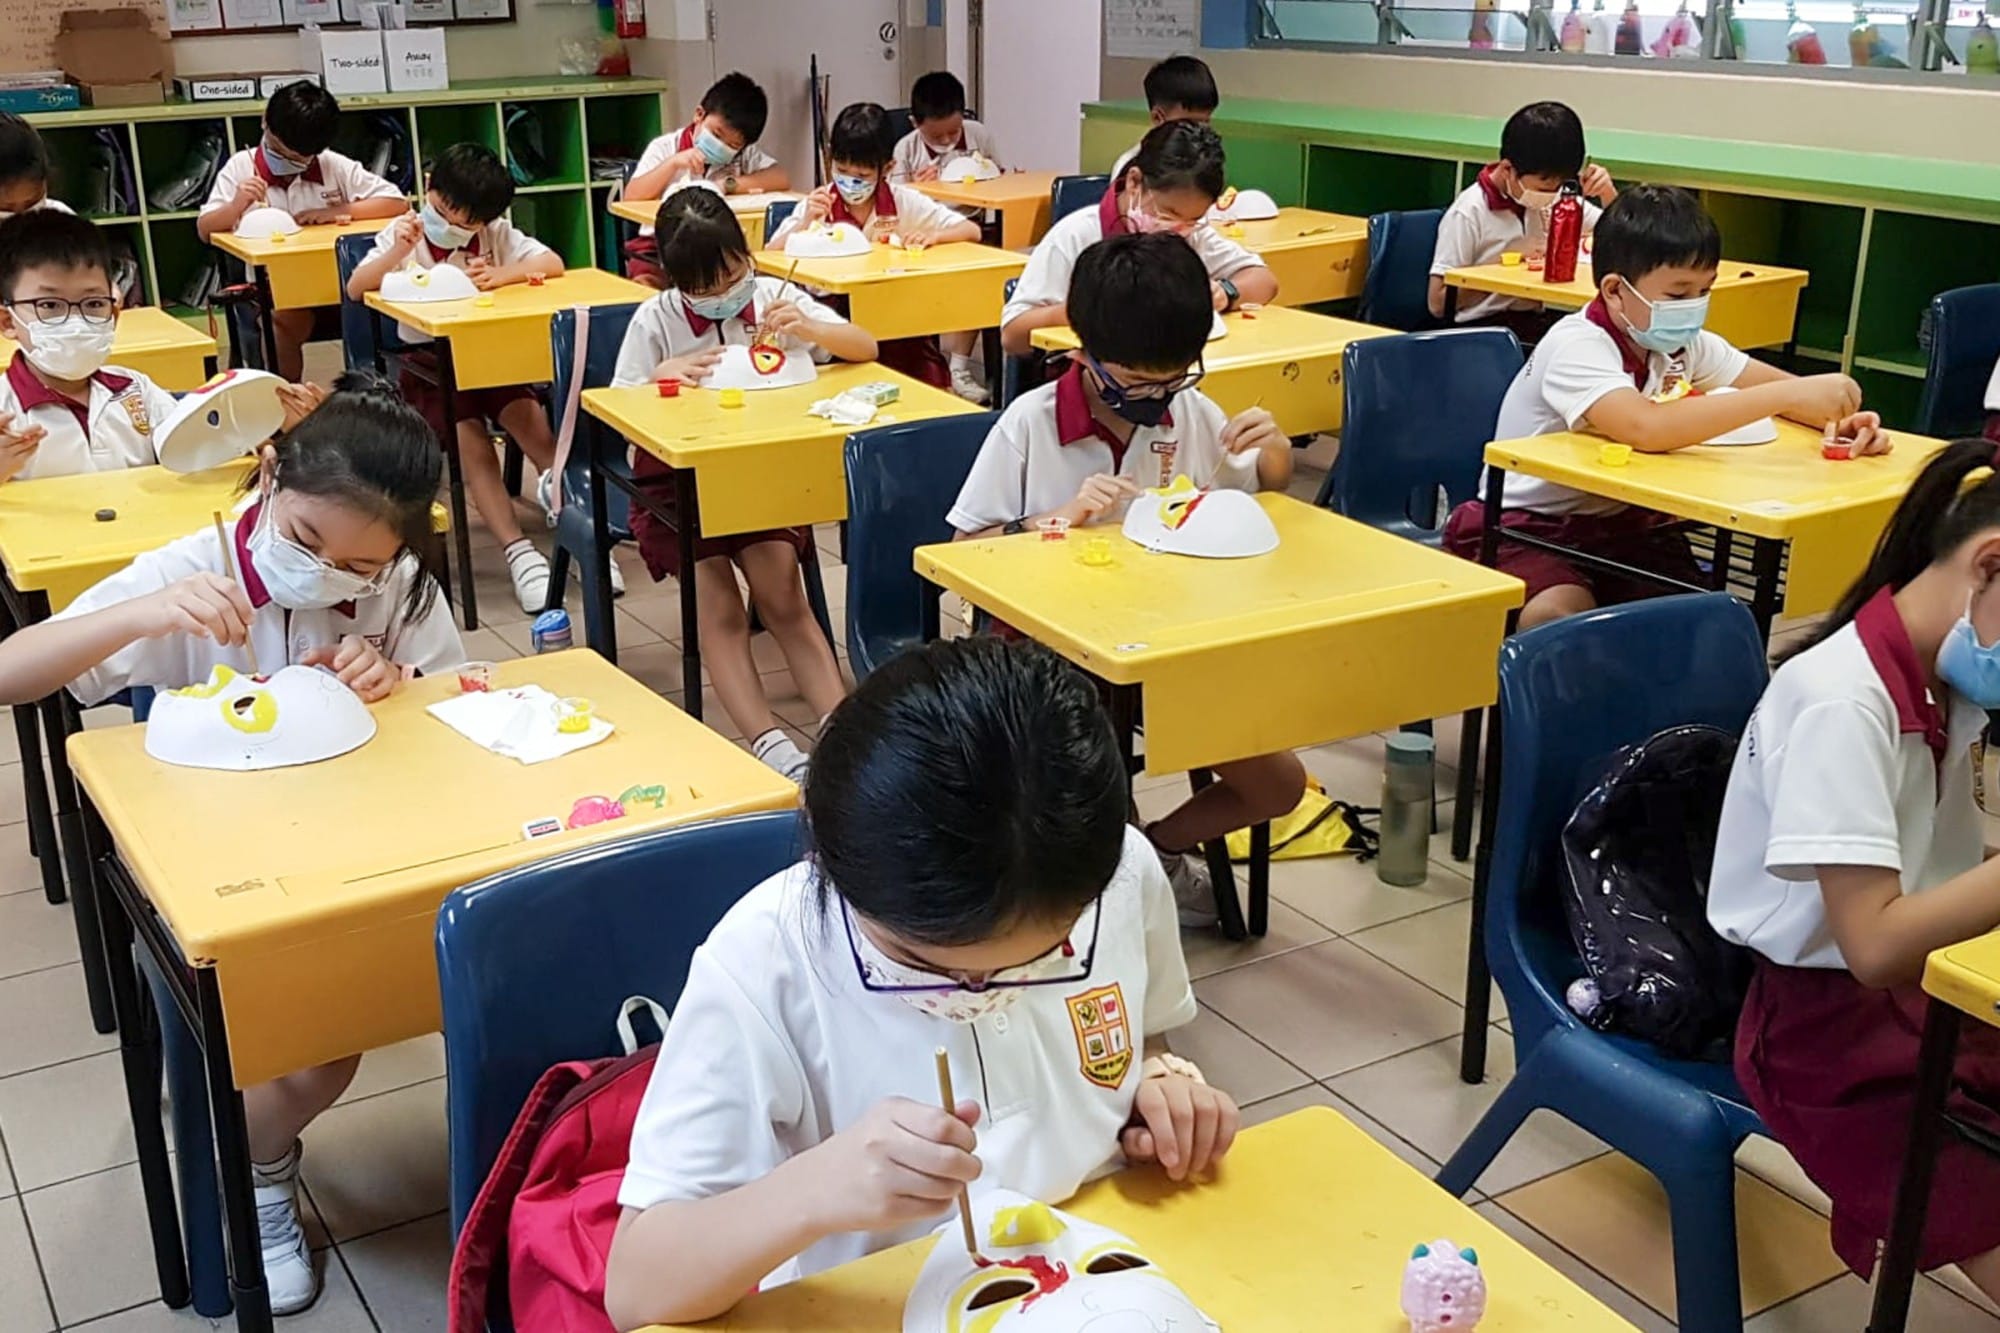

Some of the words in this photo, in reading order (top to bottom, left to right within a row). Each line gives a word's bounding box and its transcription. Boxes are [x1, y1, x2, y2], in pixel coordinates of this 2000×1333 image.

[329, 57, 380, 68] Two-sided
[405, 51, 432, 63] Away
[199, 84, 249, 95] One-sided
